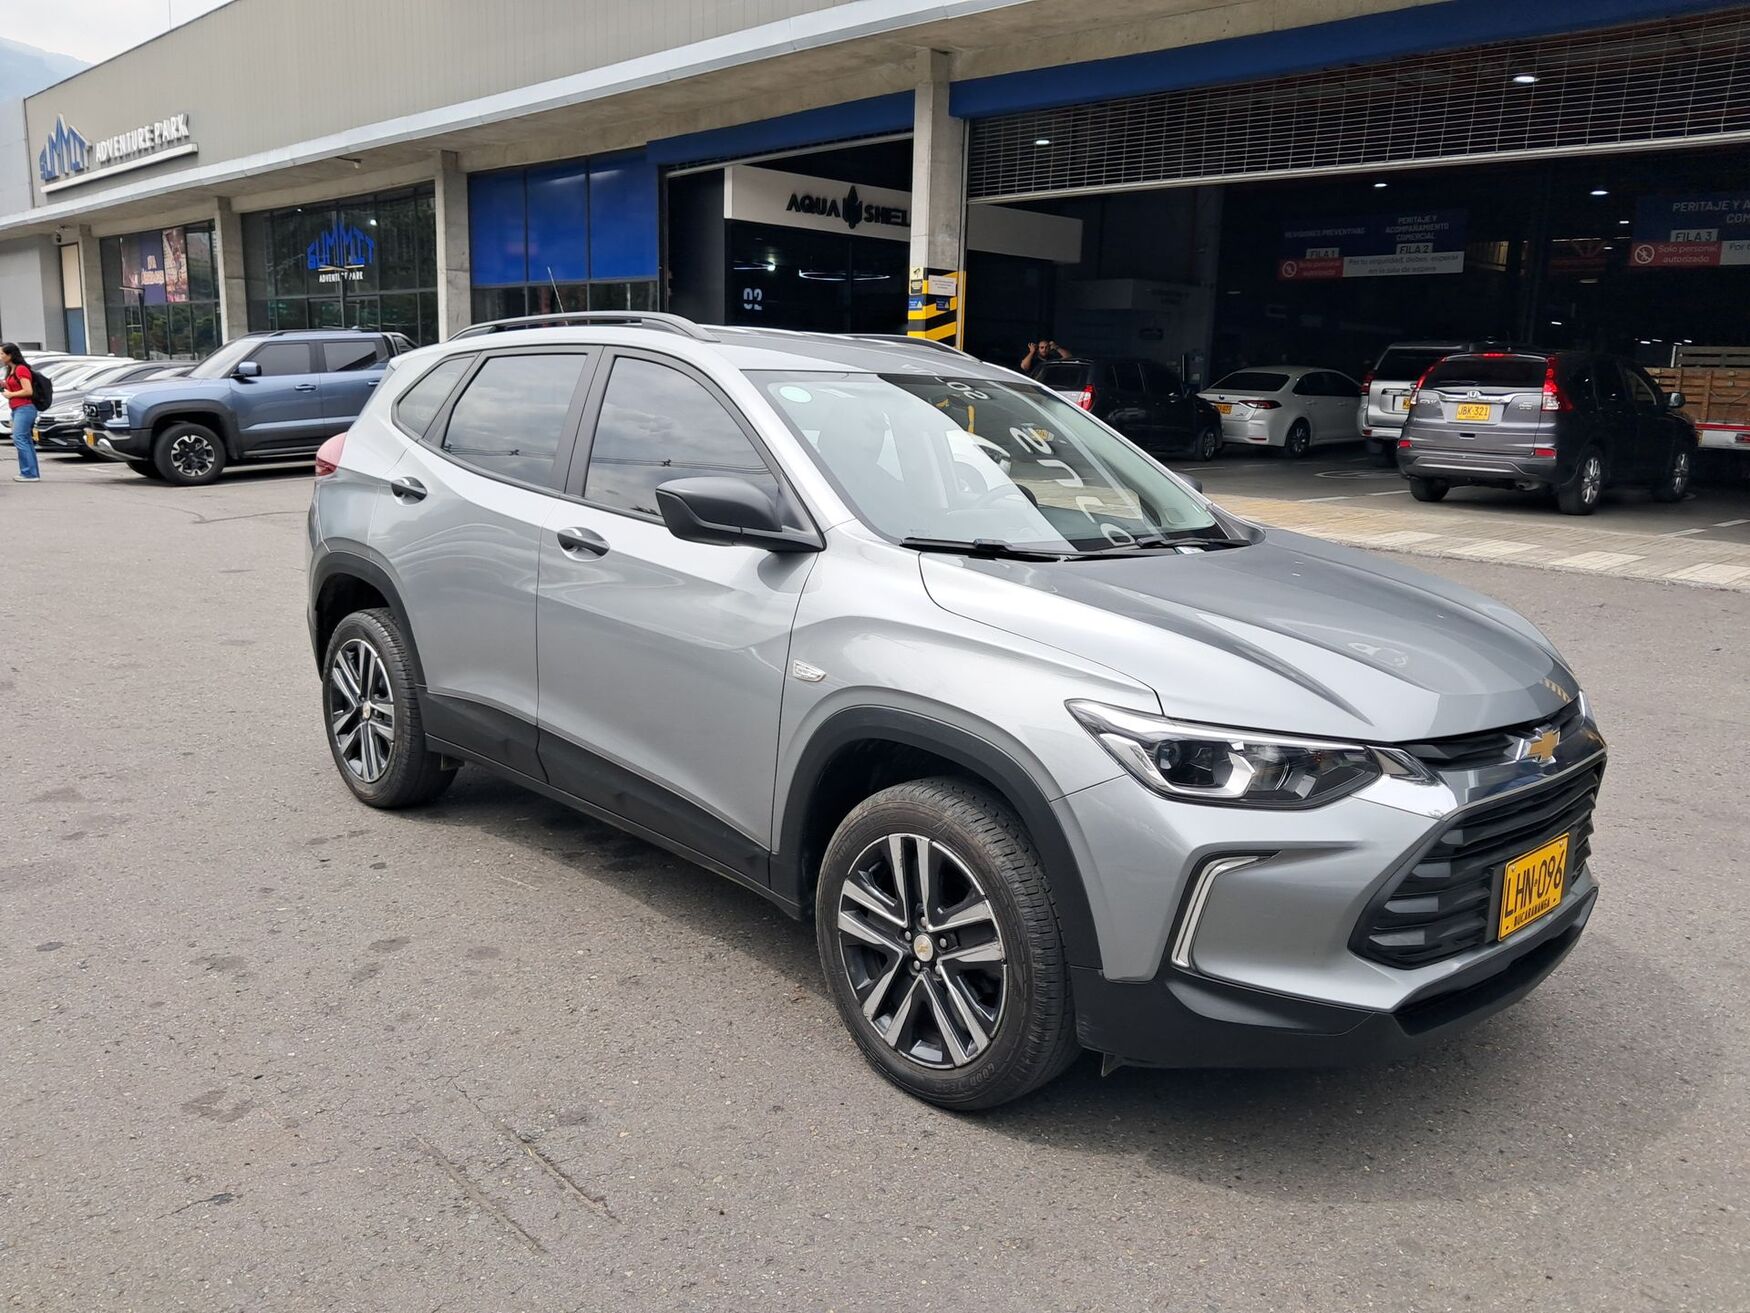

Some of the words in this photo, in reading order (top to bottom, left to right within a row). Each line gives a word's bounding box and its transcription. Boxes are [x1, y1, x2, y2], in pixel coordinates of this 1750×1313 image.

[95, 125, 152, 162] ADVENTURE
[154, 113, 189, 144] PARK
[786, 193, 841, 217] AQUA
[1672, 201, 1729, 212] PERITAJE
[1675, 232, 1701, 241] FILA
[1705, 231, 1712, 241] 3
[1400, 245, 1421, 253] FILA
[1423, 245, 1429, 253] 2
[743, 287, 763, 311] 02
